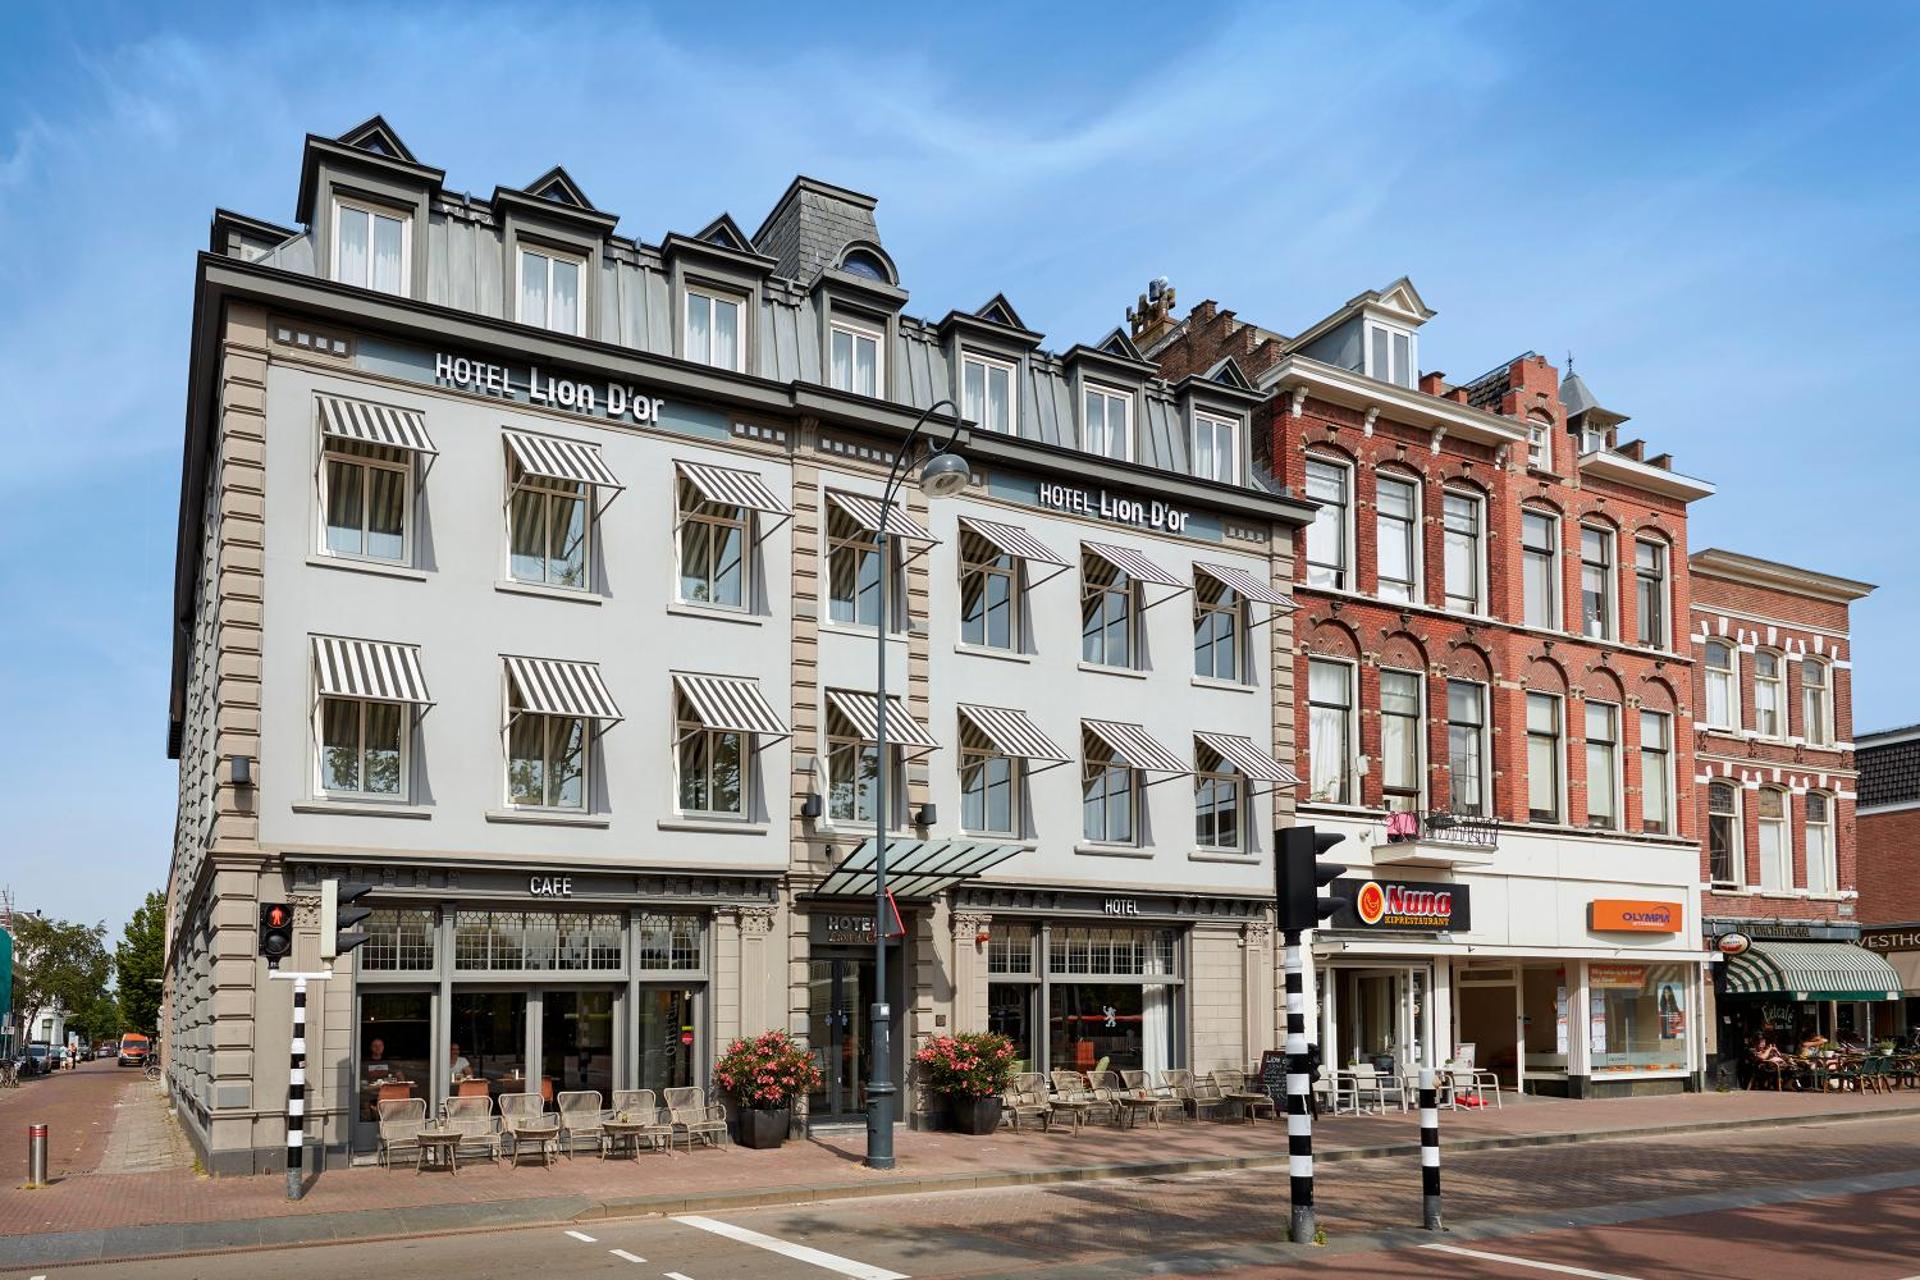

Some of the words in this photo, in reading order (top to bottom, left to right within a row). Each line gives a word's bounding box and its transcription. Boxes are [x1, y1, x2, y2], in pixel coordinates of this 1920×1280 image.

[435, 352, 516, 393] HOTEL
[1040, 482, 1092, 513] HOTEL
[1105, 898, 1140, 915] HOTEL
[1385, 885, 1451, 917] Nuna
[1384, 915, 1449, 926] KIPRESTAURANT
[1622, 912, 1670, 923] OLYMPIA
